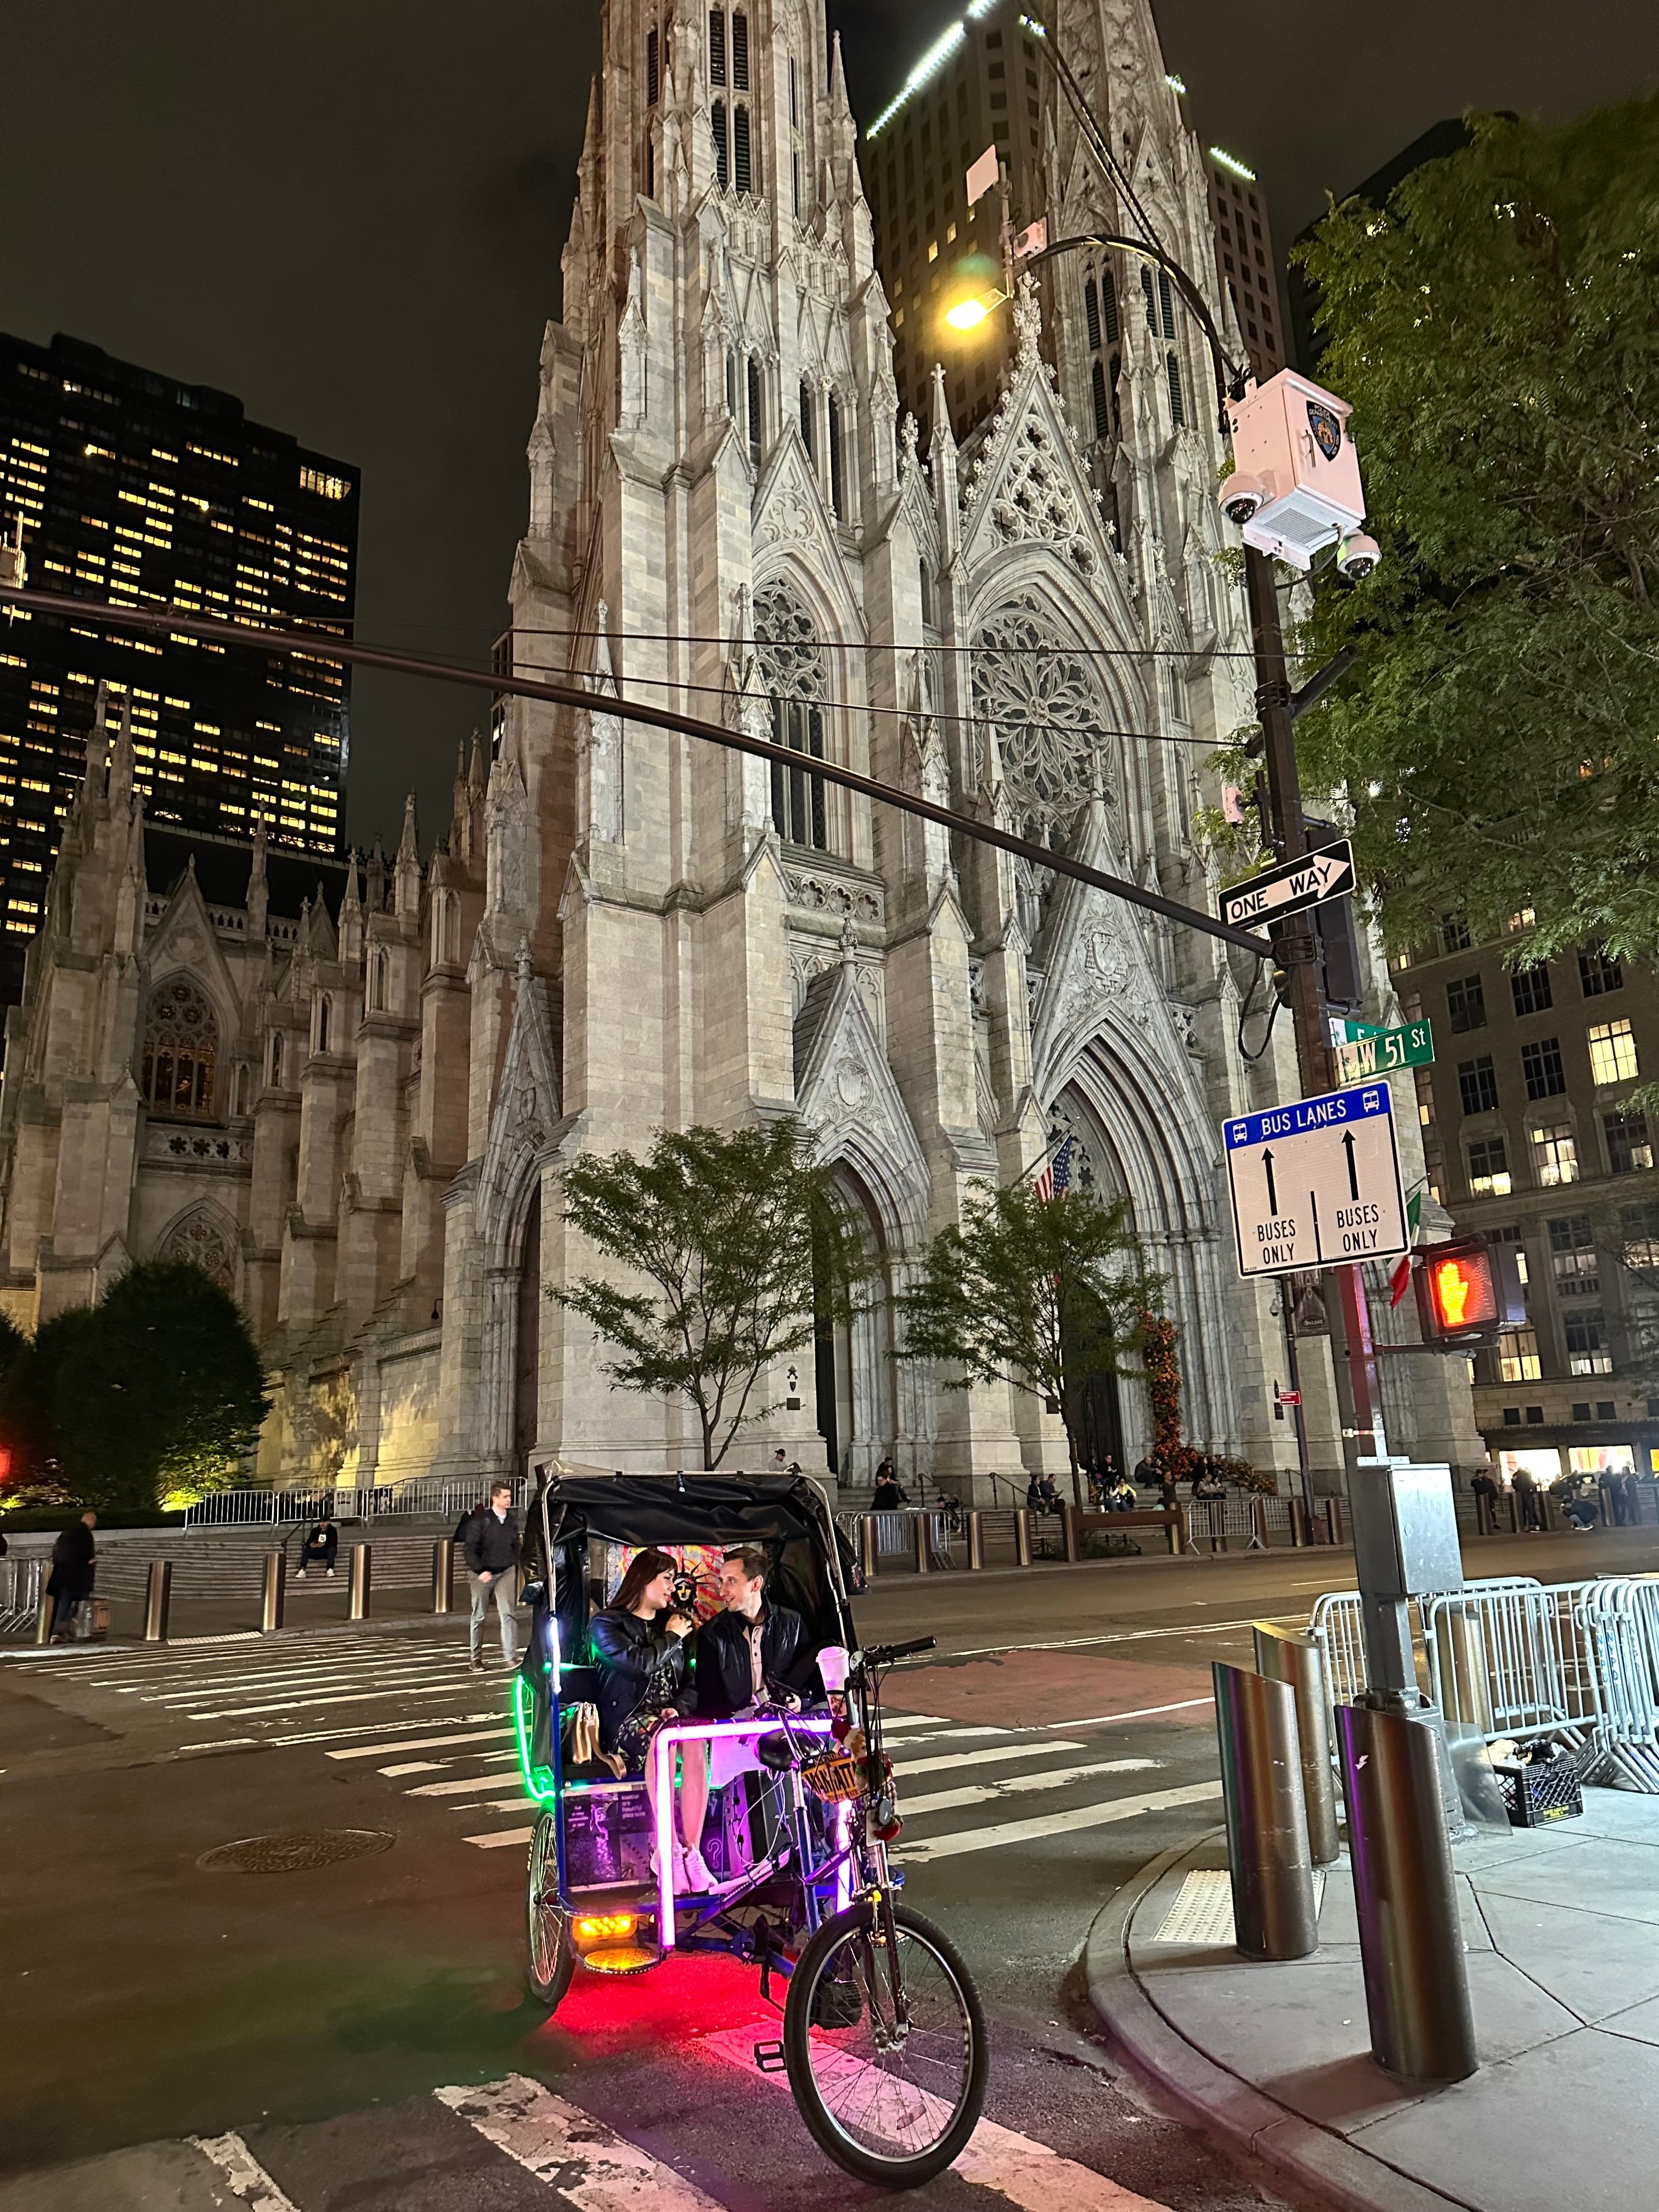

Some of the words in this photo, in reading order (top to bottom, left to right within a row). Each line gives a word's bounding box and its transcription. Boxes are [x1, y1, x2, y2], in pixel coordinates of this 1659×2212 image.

[1231, 889, 1268, 919] ONE
[1289, 862, 1332, 895] WAY
[1359, 1040, 1376, 1074] W
[1385, 1034, 1405, 1067] 51
[1411, 1028, 1426, 1048] St
[1261, 1114, 1291, 1136] BUS
[1296, 1099, 1346, 1127] LANES
[1257, 1219, 1296, 1242] BUSES
[1336, 1204, 1379, 1228] BUSES
[1263, 1243, 1294, 1265] ONLY
[1343, 1229, 1377, 1252] ONLY
[1606, 1632, 1618, 1680] NYPD
